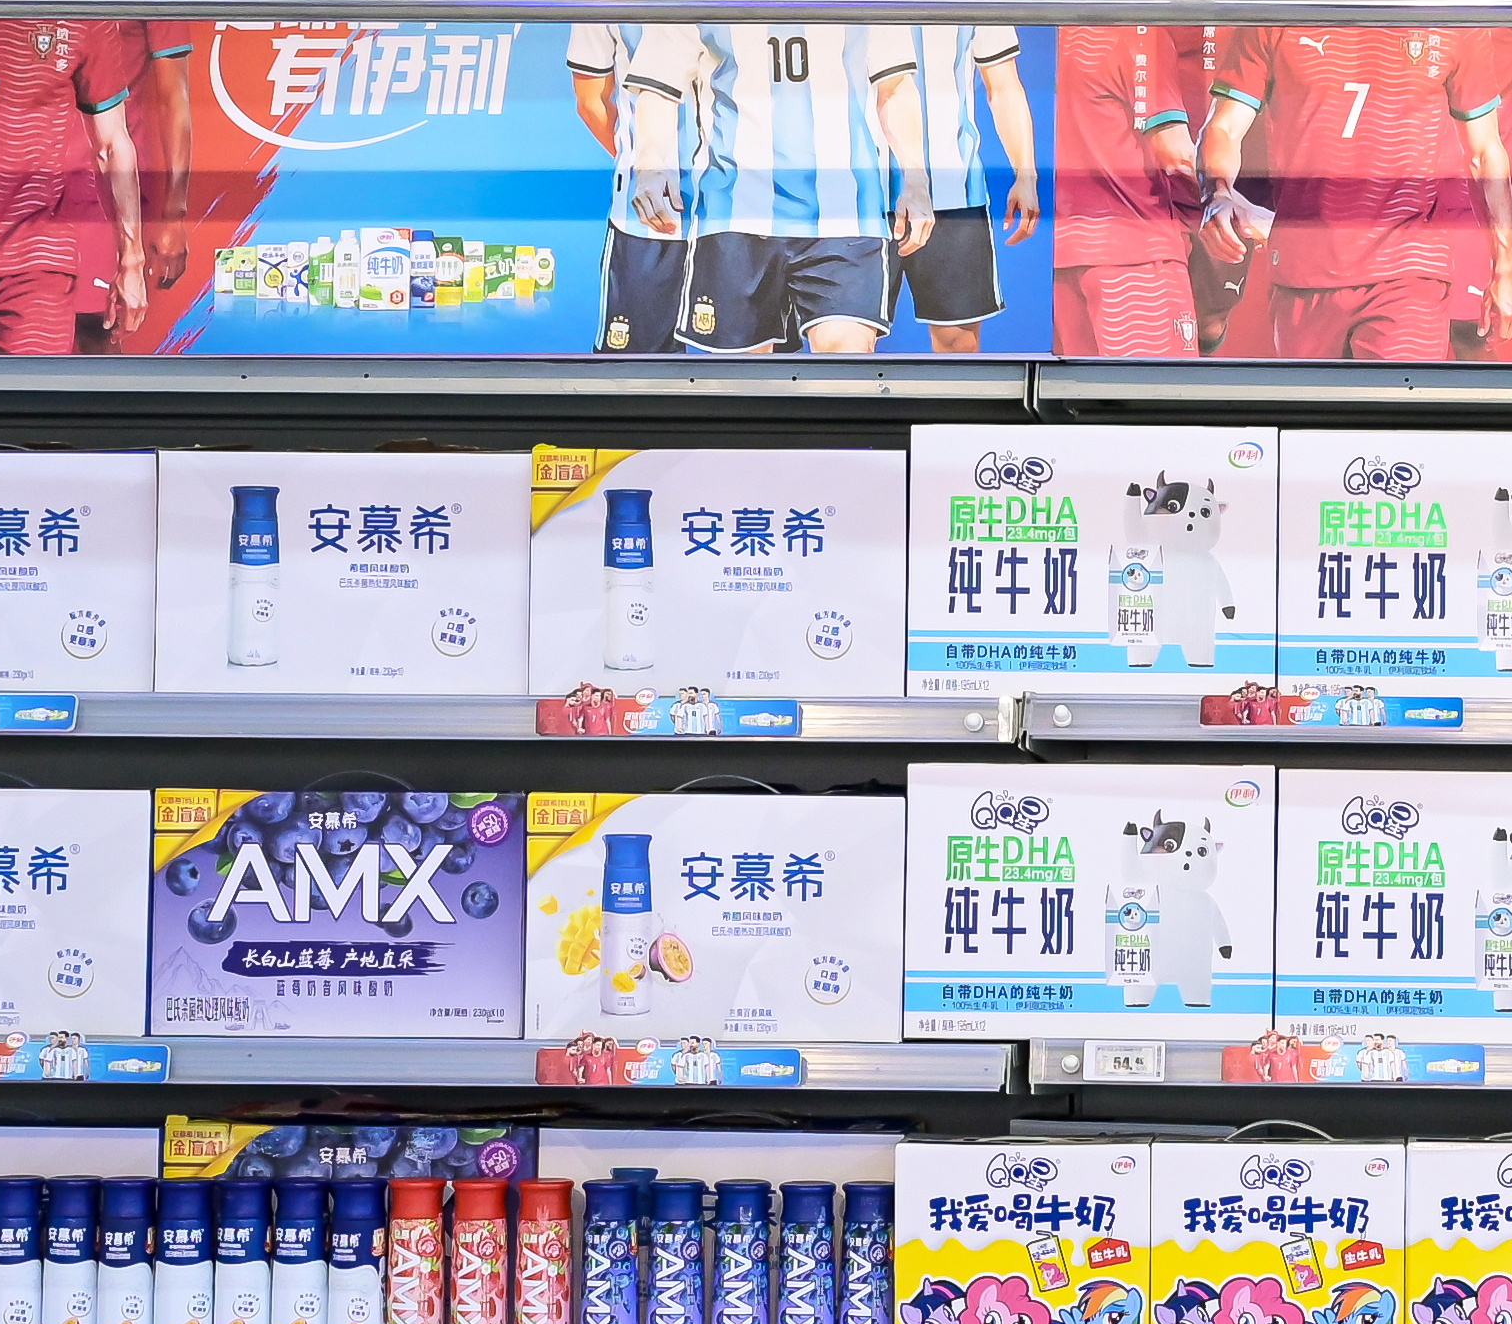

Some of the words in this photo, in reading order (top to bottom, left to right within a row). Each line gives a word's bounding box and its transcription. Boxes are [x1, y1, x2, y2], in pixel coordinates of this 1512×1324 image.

[266, 33, 508, 117] 有伊利
[767, 36, 808, 84] 10
[308, 504, 453, 554] 安慕希
[1315, 550, 1446, 621] 纯牛奶
[946, 645, 1076, 659] 自带DHA的纯牛奶
[308, 812, 357, 829] 安慕希
[208, 844, 456, 923] AMX
[681, 851, 826, 902] 安慕希
[1315, 891, 1444, 961] 纯牛奶
[242, 949, 334, 968] 长白山蓝莓
[340, 949, 415, 969] 产地直采
[929, 1195, 1116, 1239] 我爱喝牛奶
[1184, 1195, 1370, 1239] 我爱喝牛奶
[1088, 1242, 1133, 1266] 生牛乳
